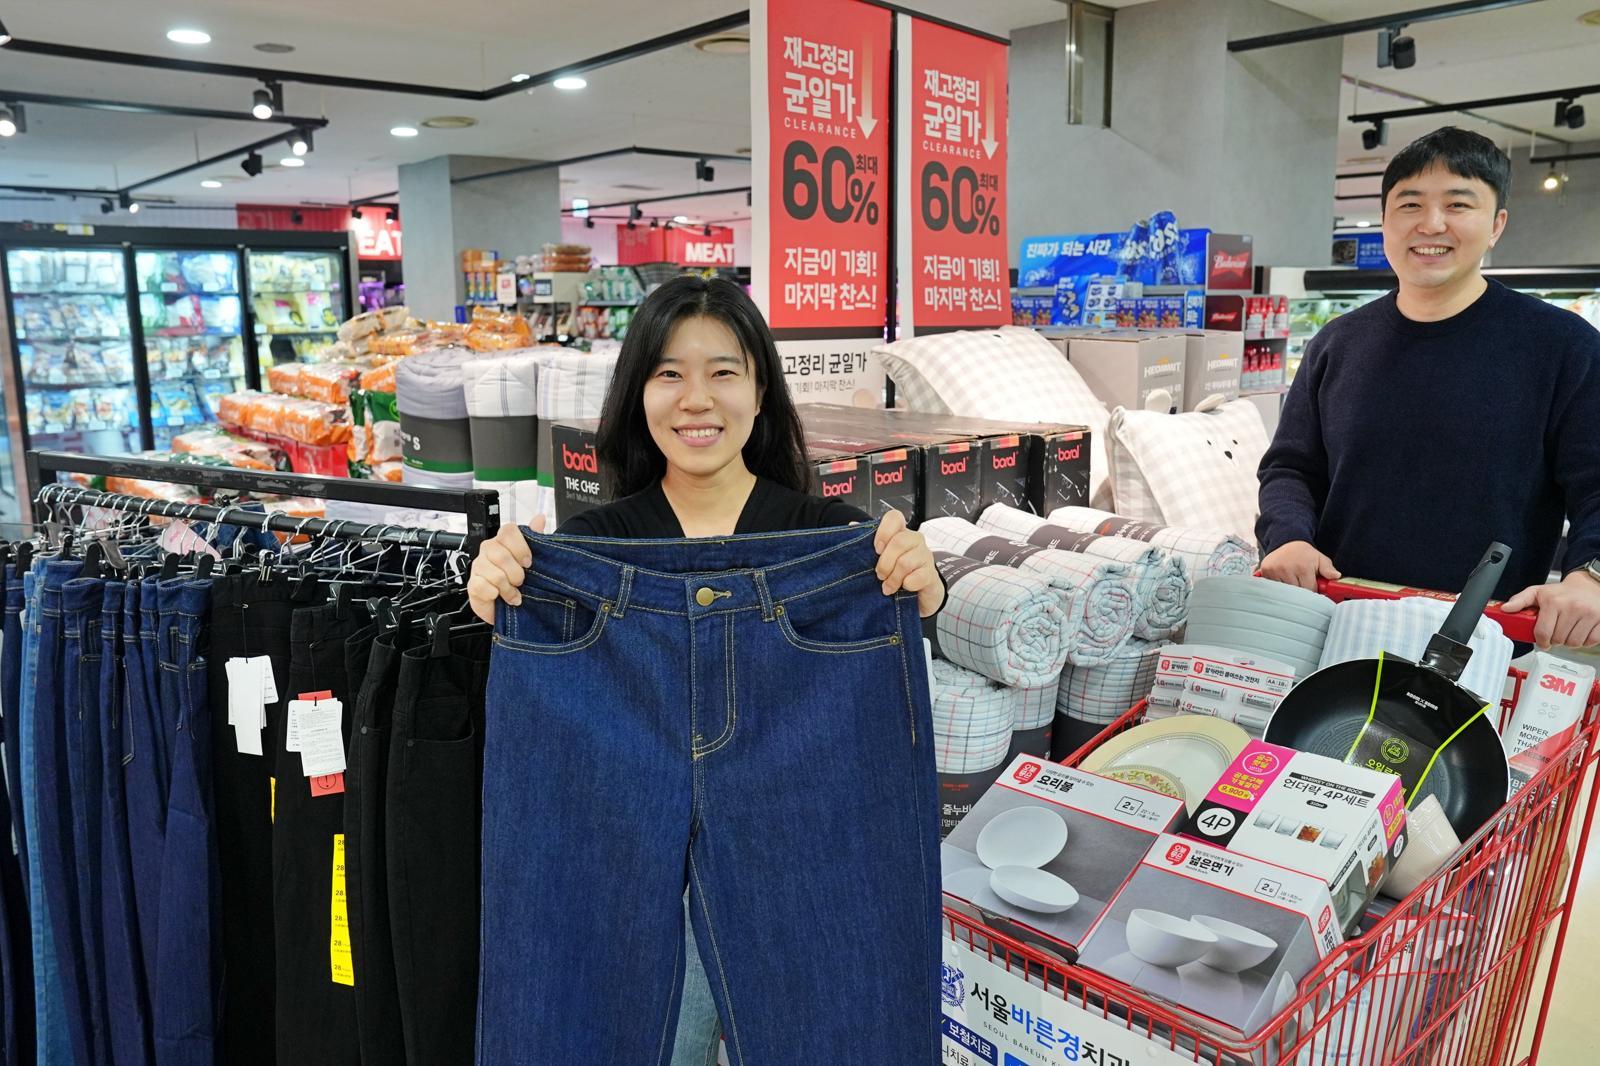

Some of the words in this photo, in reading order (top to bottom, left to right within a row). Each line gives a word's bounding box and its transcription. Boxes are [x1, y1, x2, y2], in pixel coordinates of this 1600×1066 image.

[783, 35, 854, 80] 재고정리
[783, 72, 856, 123] 균일가
[924, 68, 980, 107] 재고정리
[784, 116, 857, 139] CLEARANCE
[922, 100, 982, 146] 균일가
[922, 140, 981, 160] CLEARANCE
[855, 153, 878, 176] 최대
[782, 140, 879, 226] 60%
[979, 172, 999, 191] 최대
[921, 161, 1000, 236] 60%
[684, 241, 735, 264] MEAT
[1026, 242, 1060, 259] 진짜가
[1060, 240, 1085, 257] 되는
[1086, 239, 1112, 256] 시간
[784, 246, 836, 277] 지금이
[840, 249, 878, 278] 기회!
[923, 254, 966, 281] 지금이
[969, 256, 1001, 283] 기회!
[784, 282, 837, 311] 마지막
[839, 283, 877, 310] 찬스!
[924, 286, 967, 311] 마지막
[969, 287, 1002, 312] 찬스!
[779, 352, 825, 376] 고정리
[828, 351, 868, 374] 균일가
[814, 379, 838, 393] 마지막
[412, 436, 421, 451] S
[1057, 445, 1081, 462] boral
[562, 442, 598, 474] boral
[941, 457, 967, 475] boral
[992, 451, 1017, 470] boral
[564, 476, 580, 492] THE
[580, 479, 601, 496] CHEF
[822, 476, 854, 498] boral
[874, 465, 904, 486] boral
[1539, 672, 1577, 697] 3M
[1518, 731, 1544, 743] MORE
[1521, 723, 1549, 737] WIPER
[1516, 739, 1538, 751] THAN
[1036, 774, 1075, 794] 요리볼
[1282, 778, 1323, 797] 언더락
[1322, 790, 1371, 809] 4P세트
[1199, 813, 1232, 831] 4P
[1188, 854, 1235, 877] 넓은면기
[948, 1021, 993, 1060] 보철치료
[983, 1020, 1010, 1042] SEOUL
[1012, 1037, 1049, 1064] BAREUN
